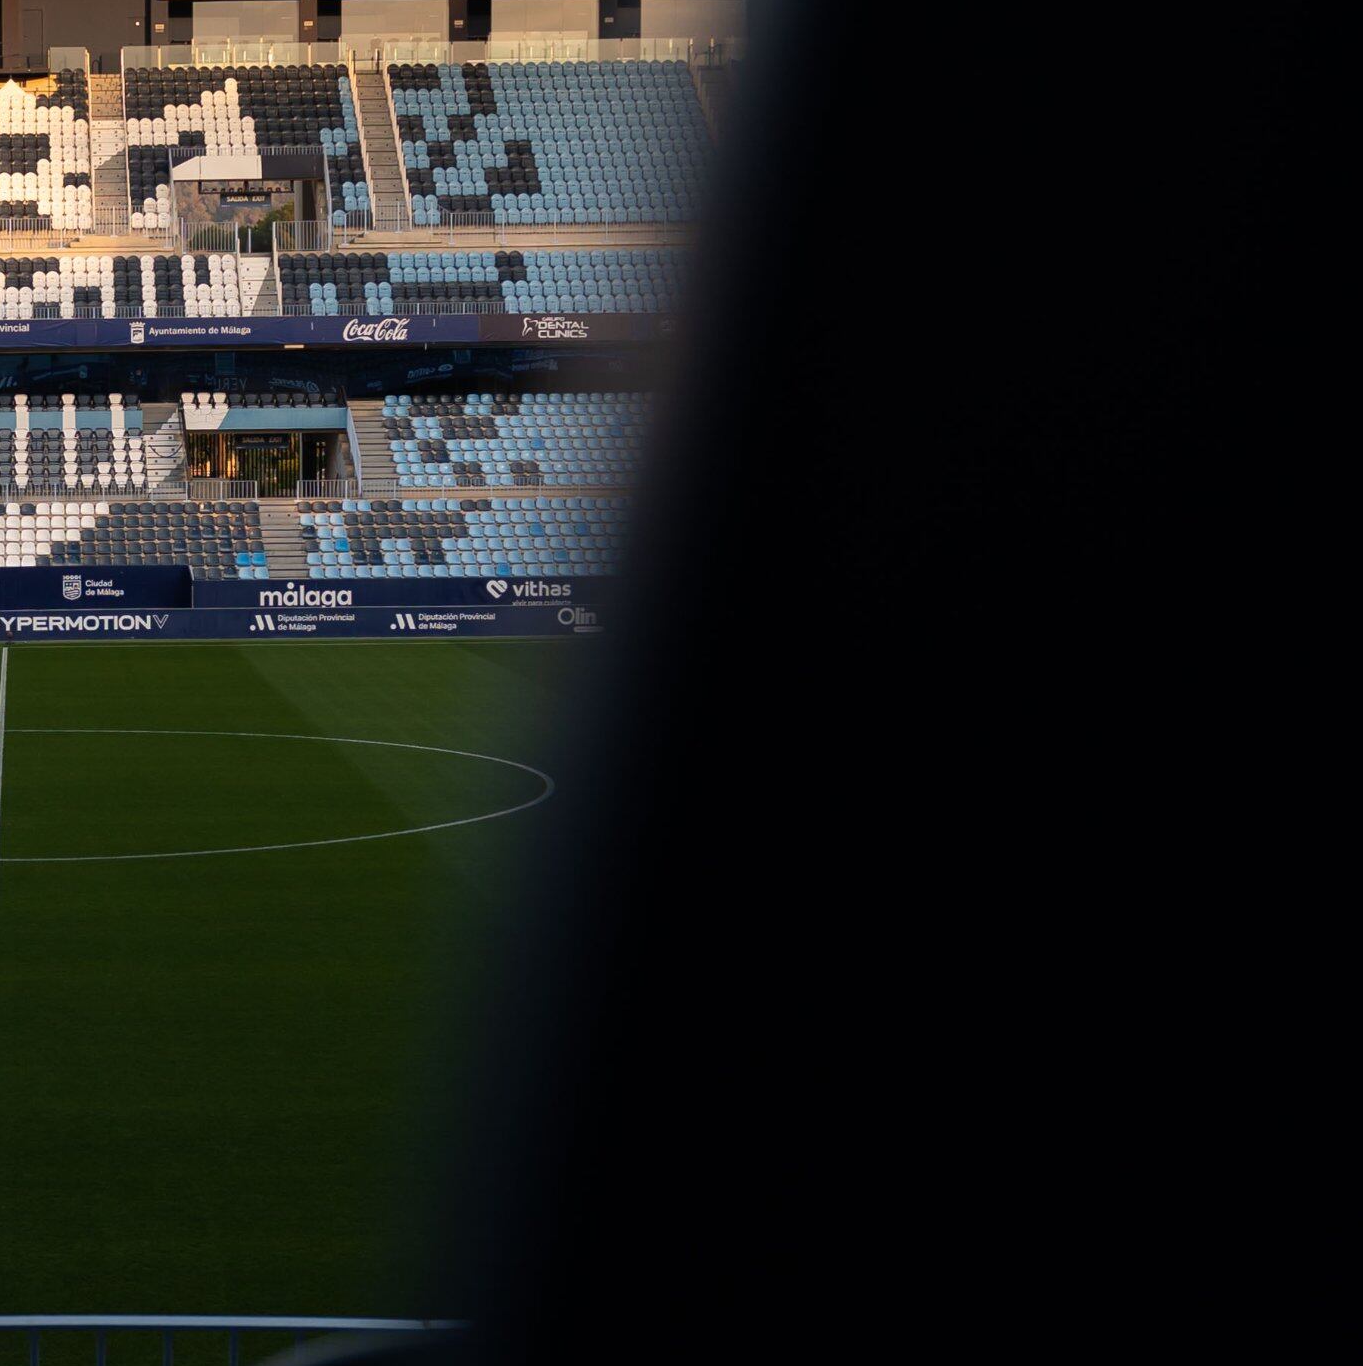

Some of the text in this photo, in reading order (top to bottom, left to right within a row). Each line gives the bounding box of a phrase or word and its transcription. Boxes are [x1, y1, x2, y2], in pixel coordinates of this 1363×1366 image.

[343, 318, 410, 342] Coca-Cola
[538, 321, 589, 330] DENTAL
[149, 325, 251, 336] Ayuntamiento de Málaga
[538, 329, 587, 338] CLINICS
[85, 579, 113, 587] Ciudad
[97, 588, 124, 597] Málaga
[512, 581, 571, 597] vithas
[277, 614, 355, 623] Diputación Provincial
[418, 612, 495, 622] Diputación Provincial
[557, 607, 597, 625] Olin
[289, 623, 316, 632] Málaga
[429, 622, 456, 631] Málaga
